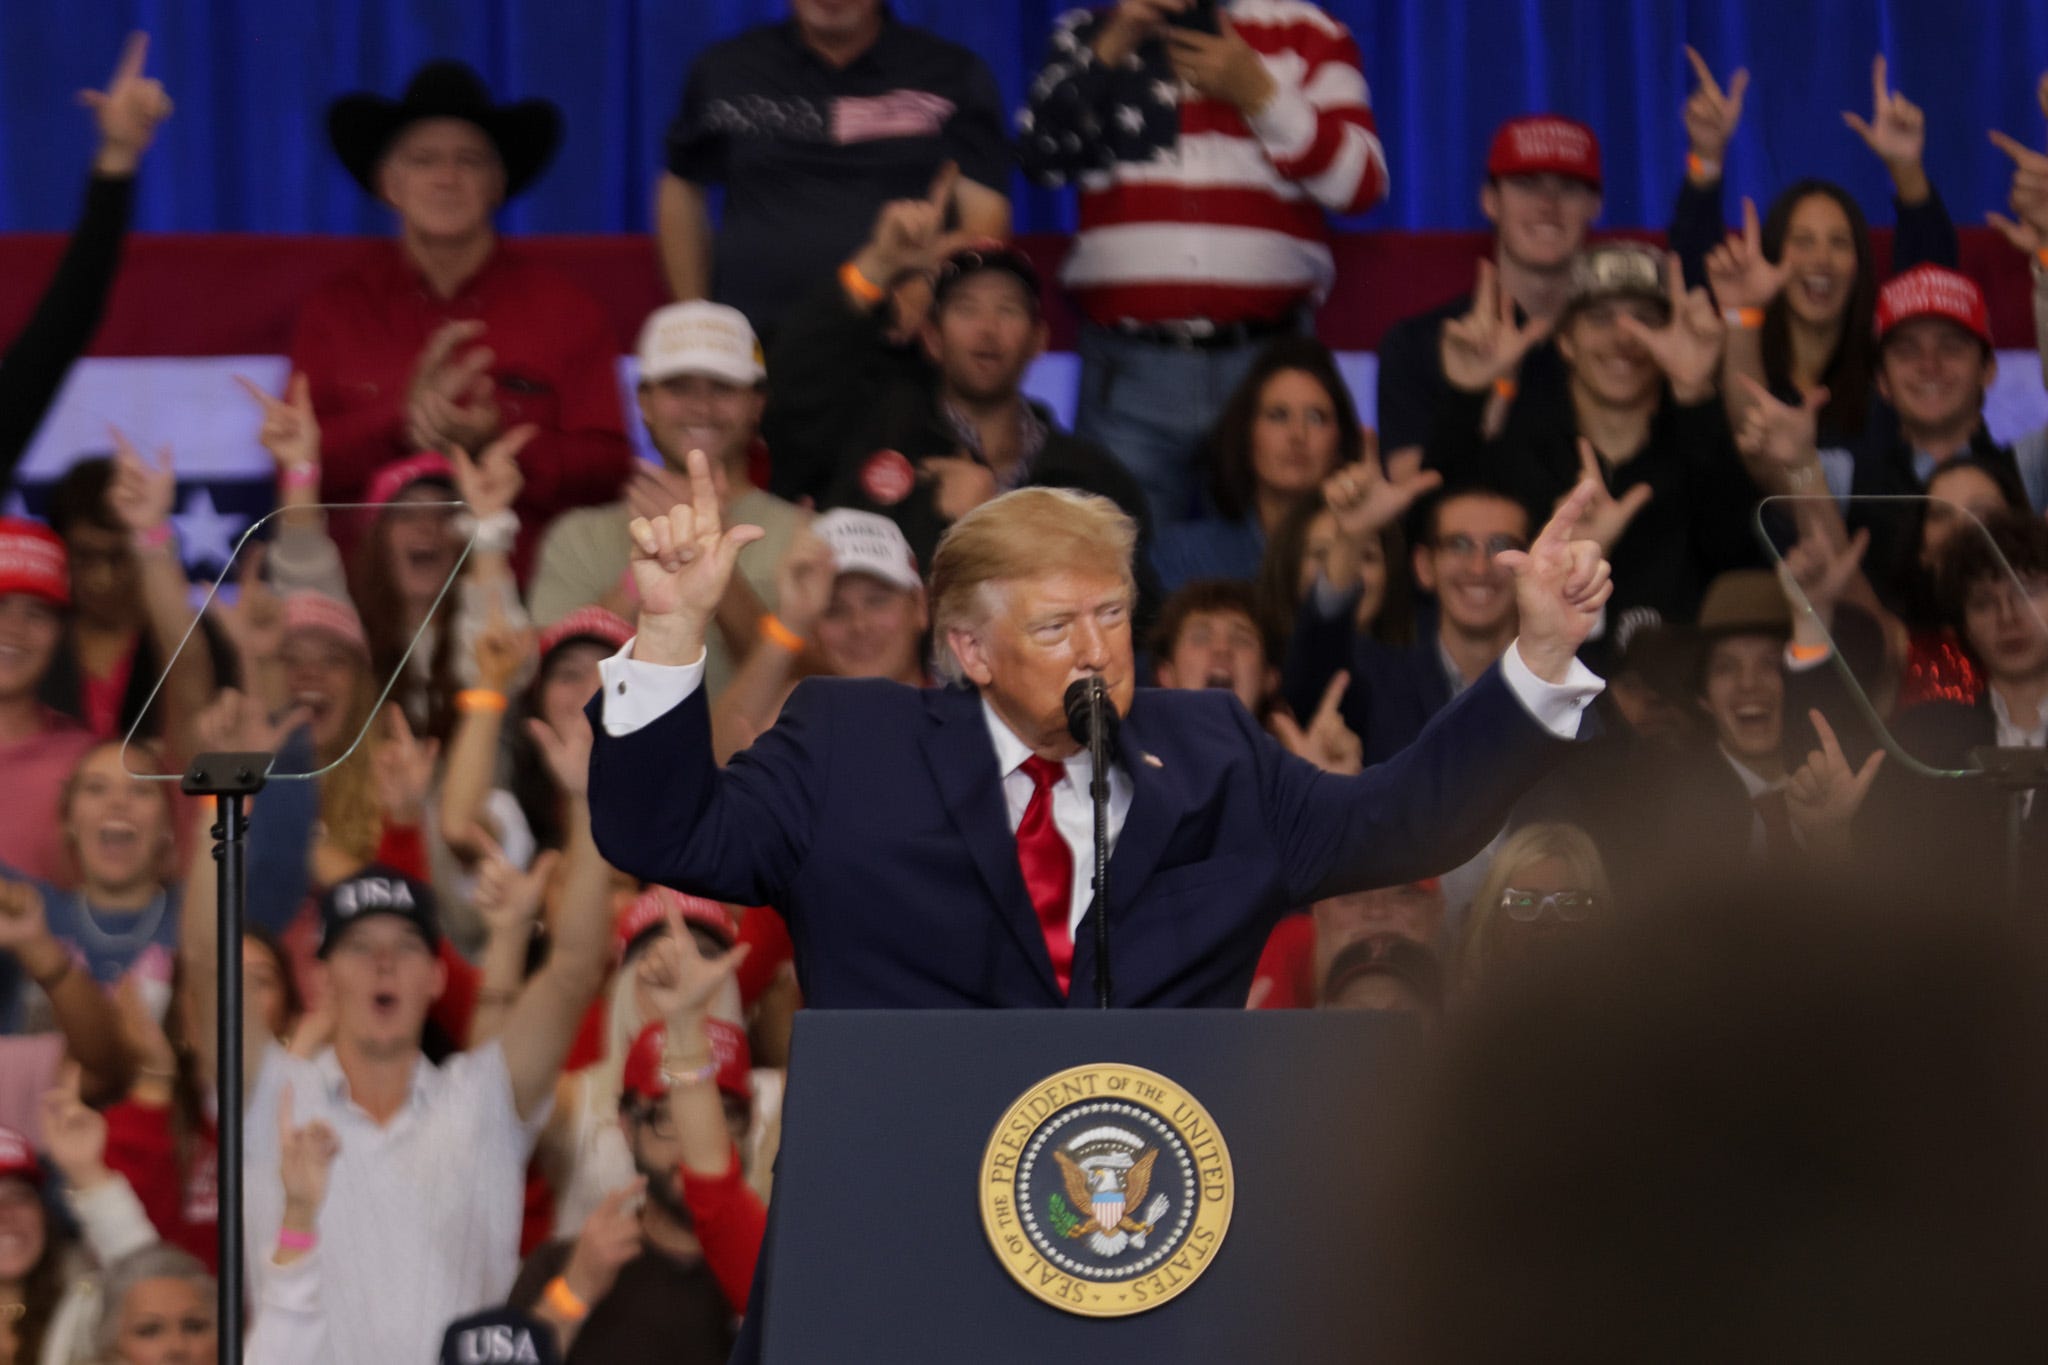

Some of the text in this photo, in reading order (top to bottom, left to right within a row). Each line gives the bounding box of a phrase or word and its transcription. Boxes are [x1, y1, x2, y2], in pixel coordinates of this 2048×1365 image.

[335, 877, 416, 918] USA
[992, 1074, 1225, 1304] SEAL OF THE PRESIDENT OF THE UNITED STATES
[458, 1324, 540, 1365] USA
